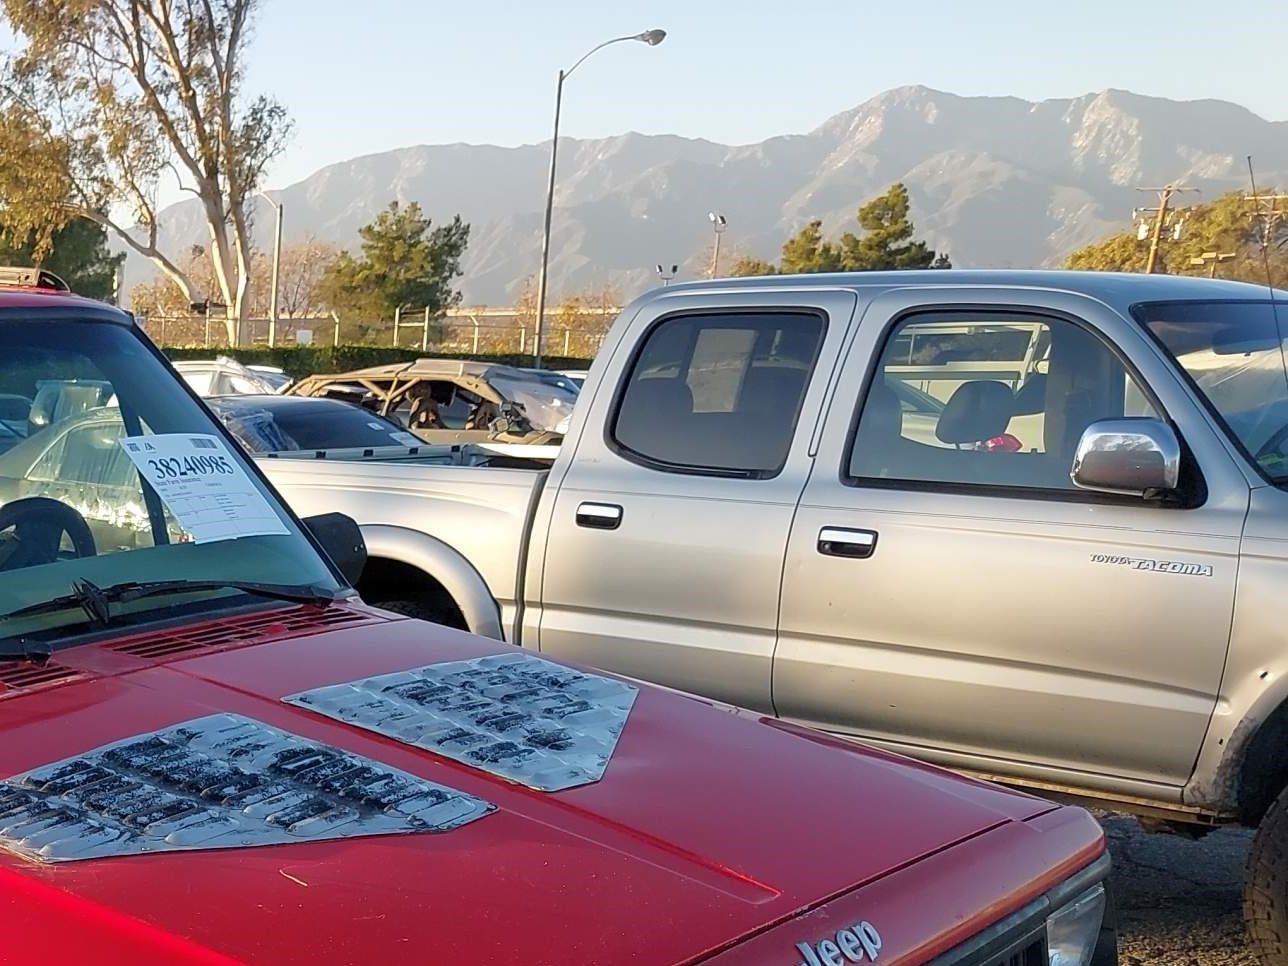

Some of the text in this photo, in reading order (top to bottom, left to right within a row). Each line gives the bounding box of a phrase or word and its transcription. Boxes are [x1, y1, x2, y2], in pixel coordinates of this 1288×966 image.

[148, 455, 234, 479] 38240985
[1090, 553, 1213, 576] TOYOTA TACOMA
